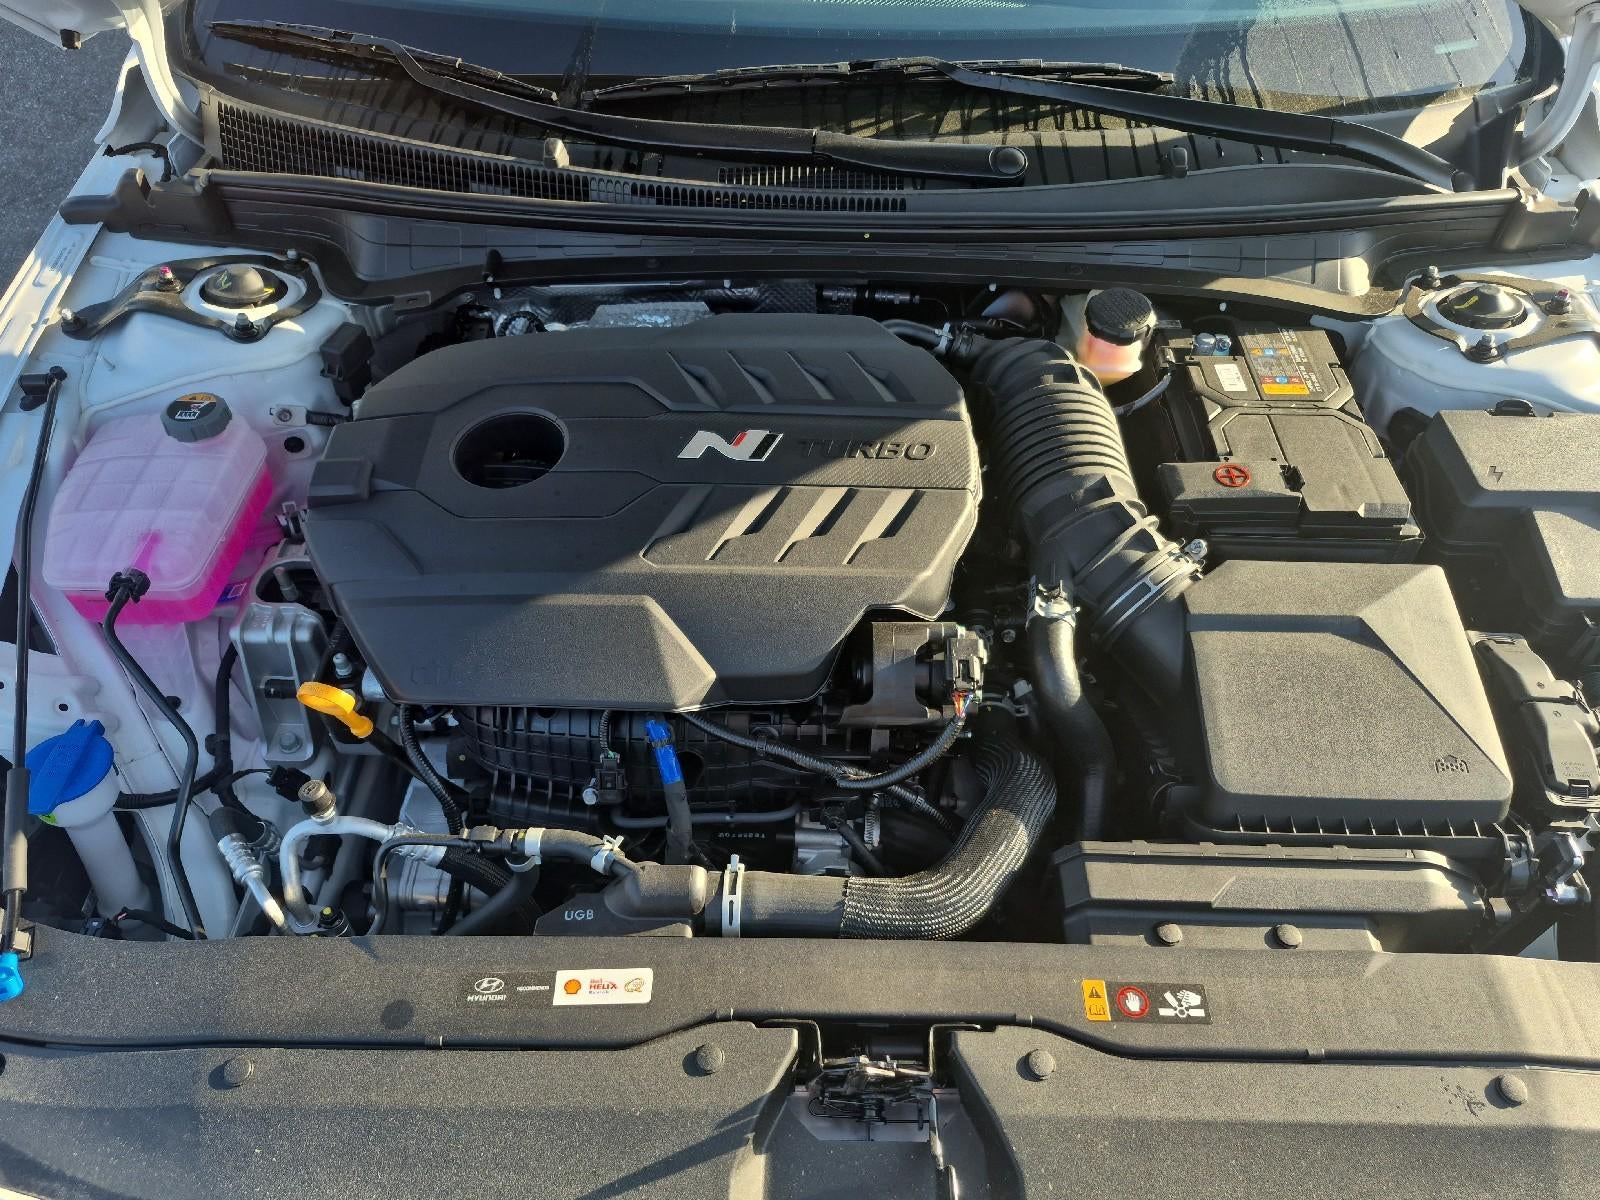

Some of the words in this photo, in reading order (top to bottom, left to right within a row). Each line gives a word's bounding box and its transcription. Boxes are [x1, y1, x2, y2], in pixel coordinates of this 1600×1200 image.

[798, 438, 937, 461] TURBO
[564, 908, 594, 921] UGB
[589, 983, 618, 991] HELIX
[466, 994, 507, 1002] HYUNDAI
